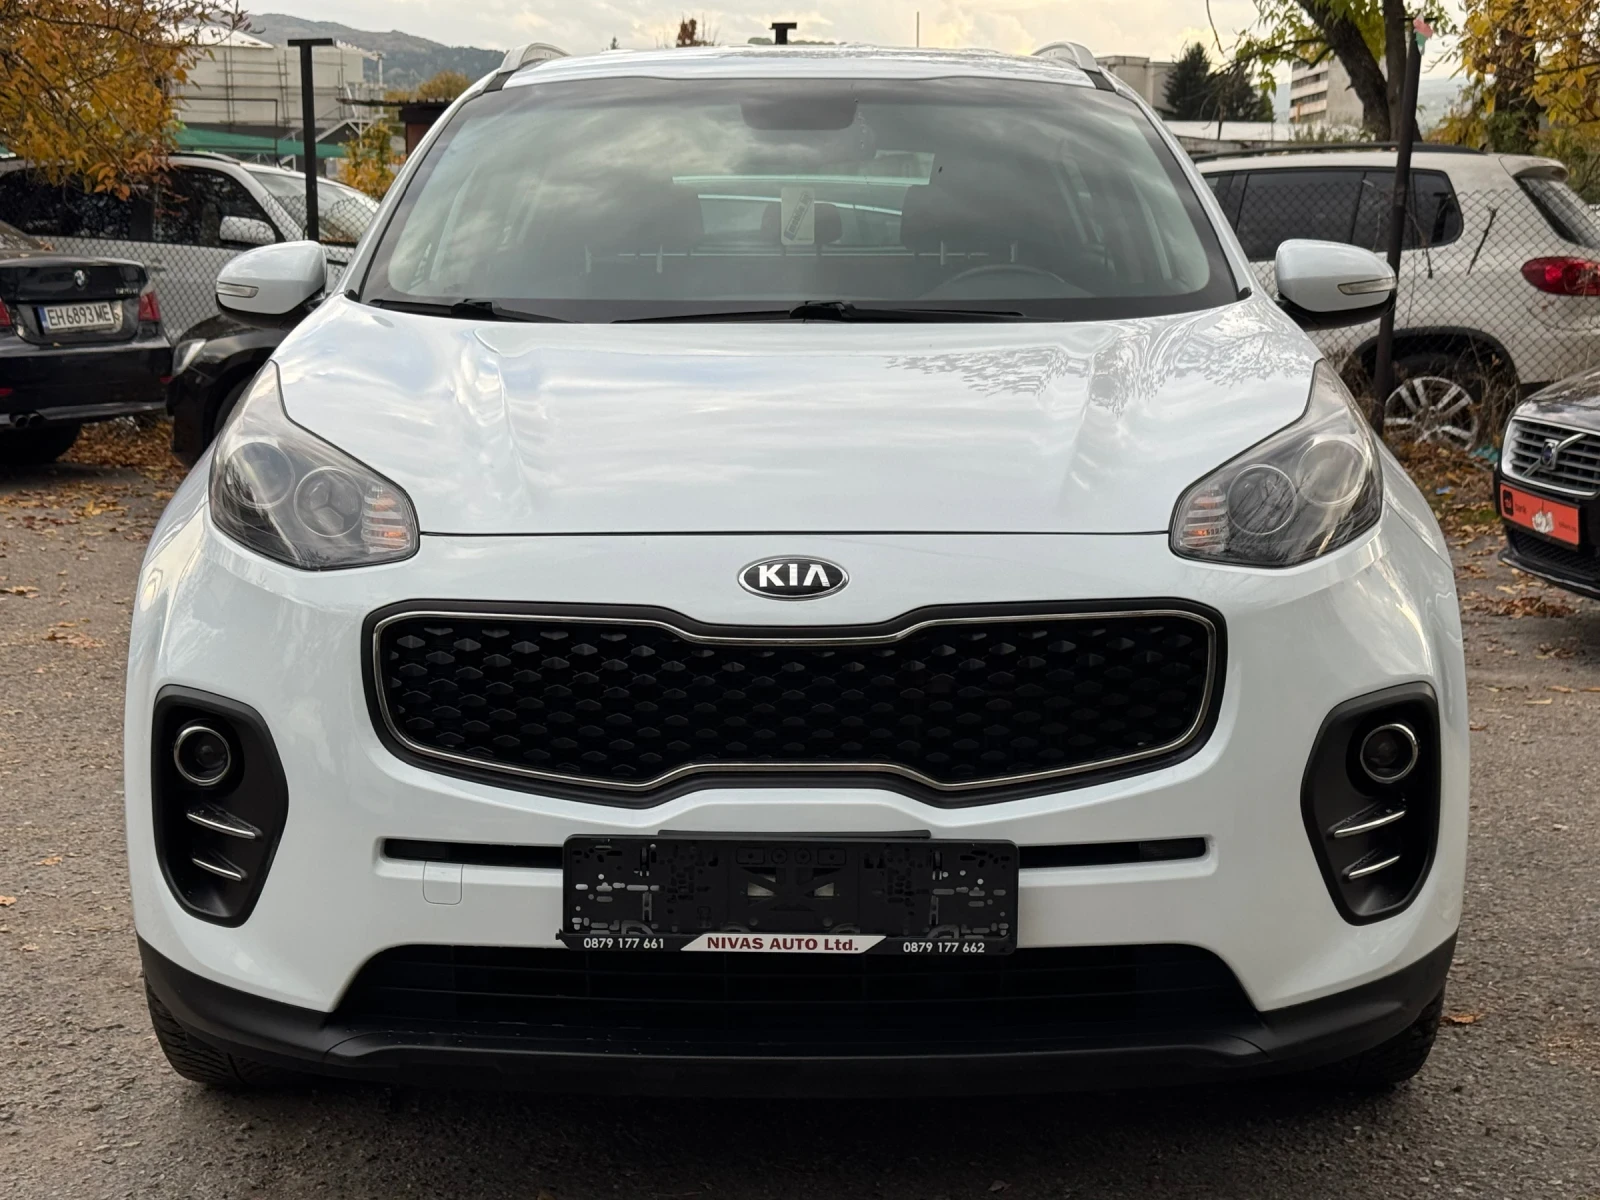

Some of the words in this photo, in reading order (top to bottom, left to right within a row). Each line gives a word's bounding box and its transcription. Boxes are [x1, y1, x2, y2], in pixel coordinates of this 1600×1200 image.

[758, 563, 830, 587] KIA
[583, 937, 613, 949] 0879
[618, 937, 640, 949] 177
[643, 937, 664, 949] 661
[707, 936, 764, 950] NIVAS
[769, 937, 818, 951] AUTO
[824, 938, 859, 951] Ltd.
[903, 942, 933, 953] 0879
[937, 942, 959, 953] 177
[962, 942, 985, 953] 662
